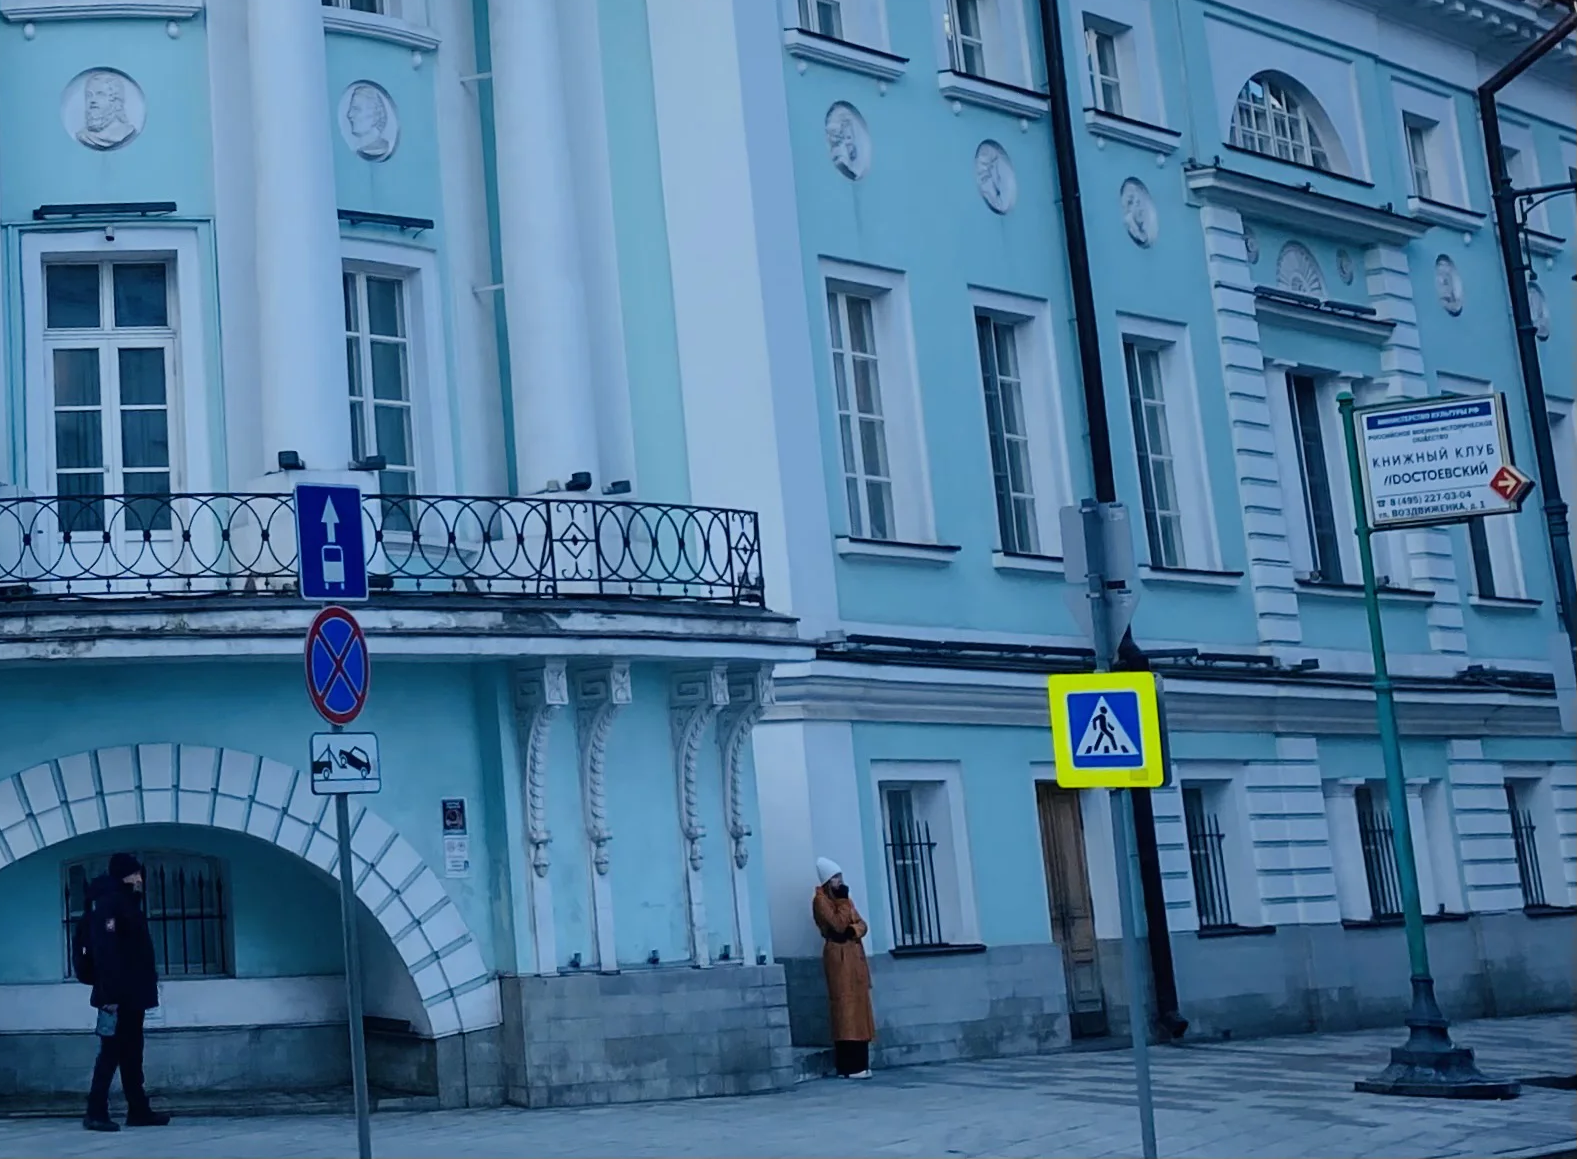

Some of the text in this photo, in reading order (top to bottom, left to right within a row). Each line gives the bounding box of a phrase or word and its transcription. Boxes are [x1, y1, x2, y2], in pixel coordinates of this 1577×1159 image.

[1372, 443, 1495, 468] КНИЖНЫЙ КЛУБ
[1398, 496, 1422, 506] (495)
[1424, 490, 1472, 503] 227-03-04
